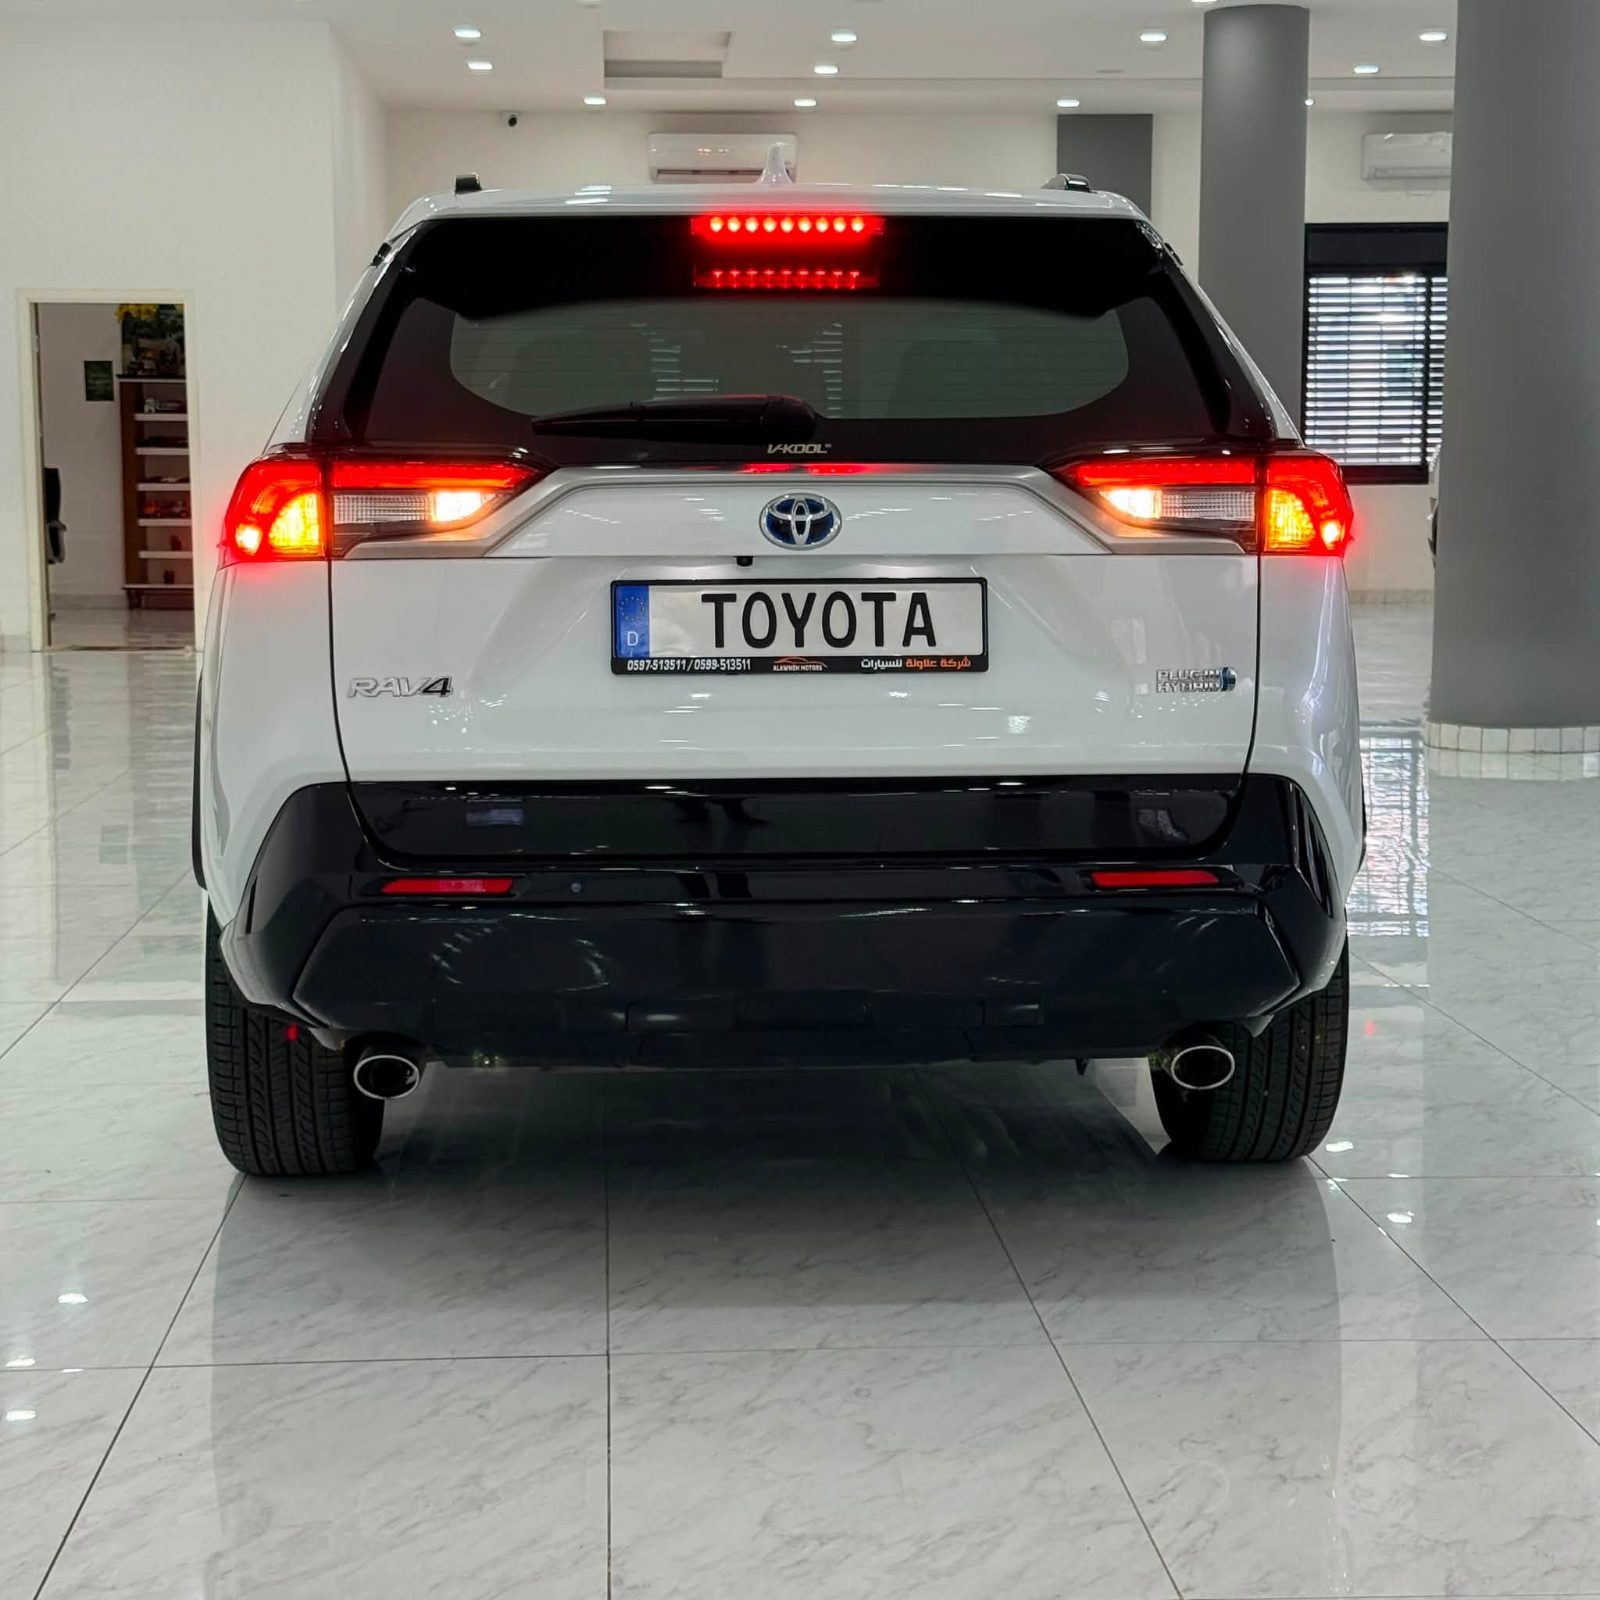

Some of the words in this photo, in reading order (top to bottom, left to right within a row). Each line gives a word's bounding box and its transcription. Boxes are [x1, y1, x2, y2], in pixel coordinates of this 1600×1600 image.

[767, 443, 828, 454] V-KOOL
[701, 591, 937, 648] TOYOTA
[627, 630, 639, 646] D
[800, 664, 823, 672] MOTORS
[860, 658, 903, 671] للسيارات
[940, 656, 971, 670] شركة
[346, 677, 453, 698] RAV4
[1156, 681, 1221, 693] HYBRID
